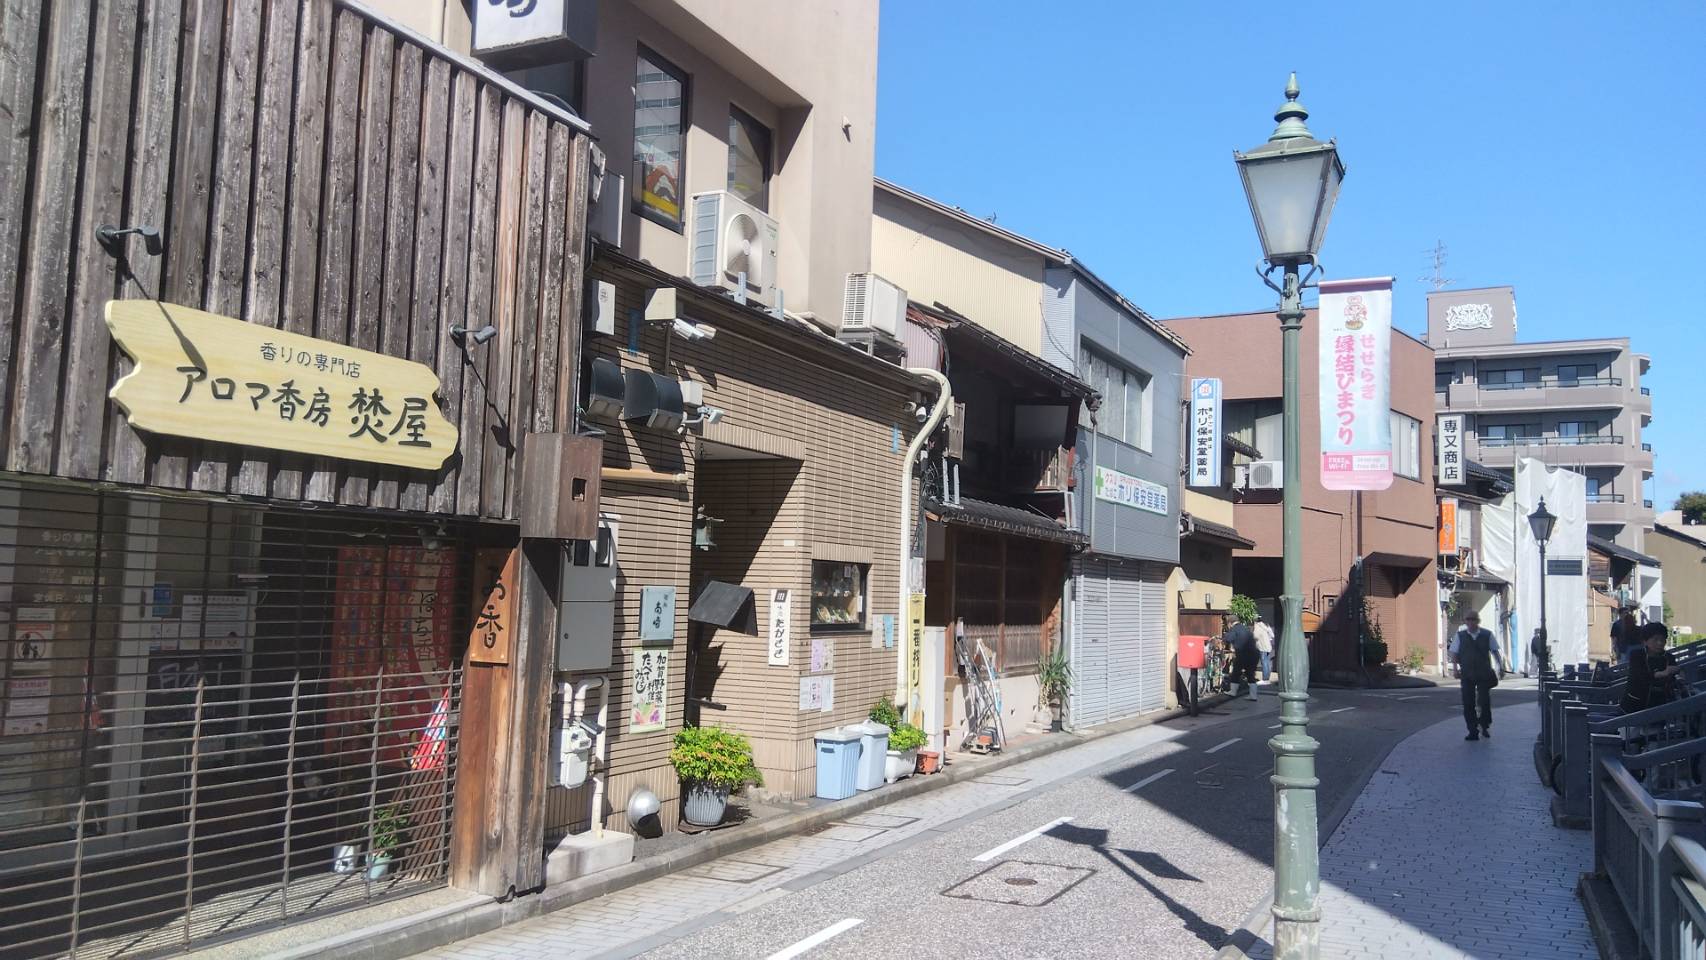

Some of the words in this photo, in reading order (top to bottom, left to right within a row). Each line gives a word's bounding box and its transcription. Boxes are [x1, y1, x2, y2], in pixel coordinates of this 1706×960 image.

[259, 342, 362, 379] 香りの専門店
[1335, 335, 1355, 446] 縁結びまつり
[1360, 334, 1375, 400] せせらぎ
[176, 366, 332, 428] アロマ香房
[347, 386, 433, 448] 焚屋
[1197, 408, 1208, 477] ホリ保安堂薬局
[1442, 420, 1458, 481] 専又商店
[1118, 484, 1166, 512] ホリ保安堂薬局
[477, 566, 507, 649] お香
[655, 652, 667, 703] 加賀野菜
